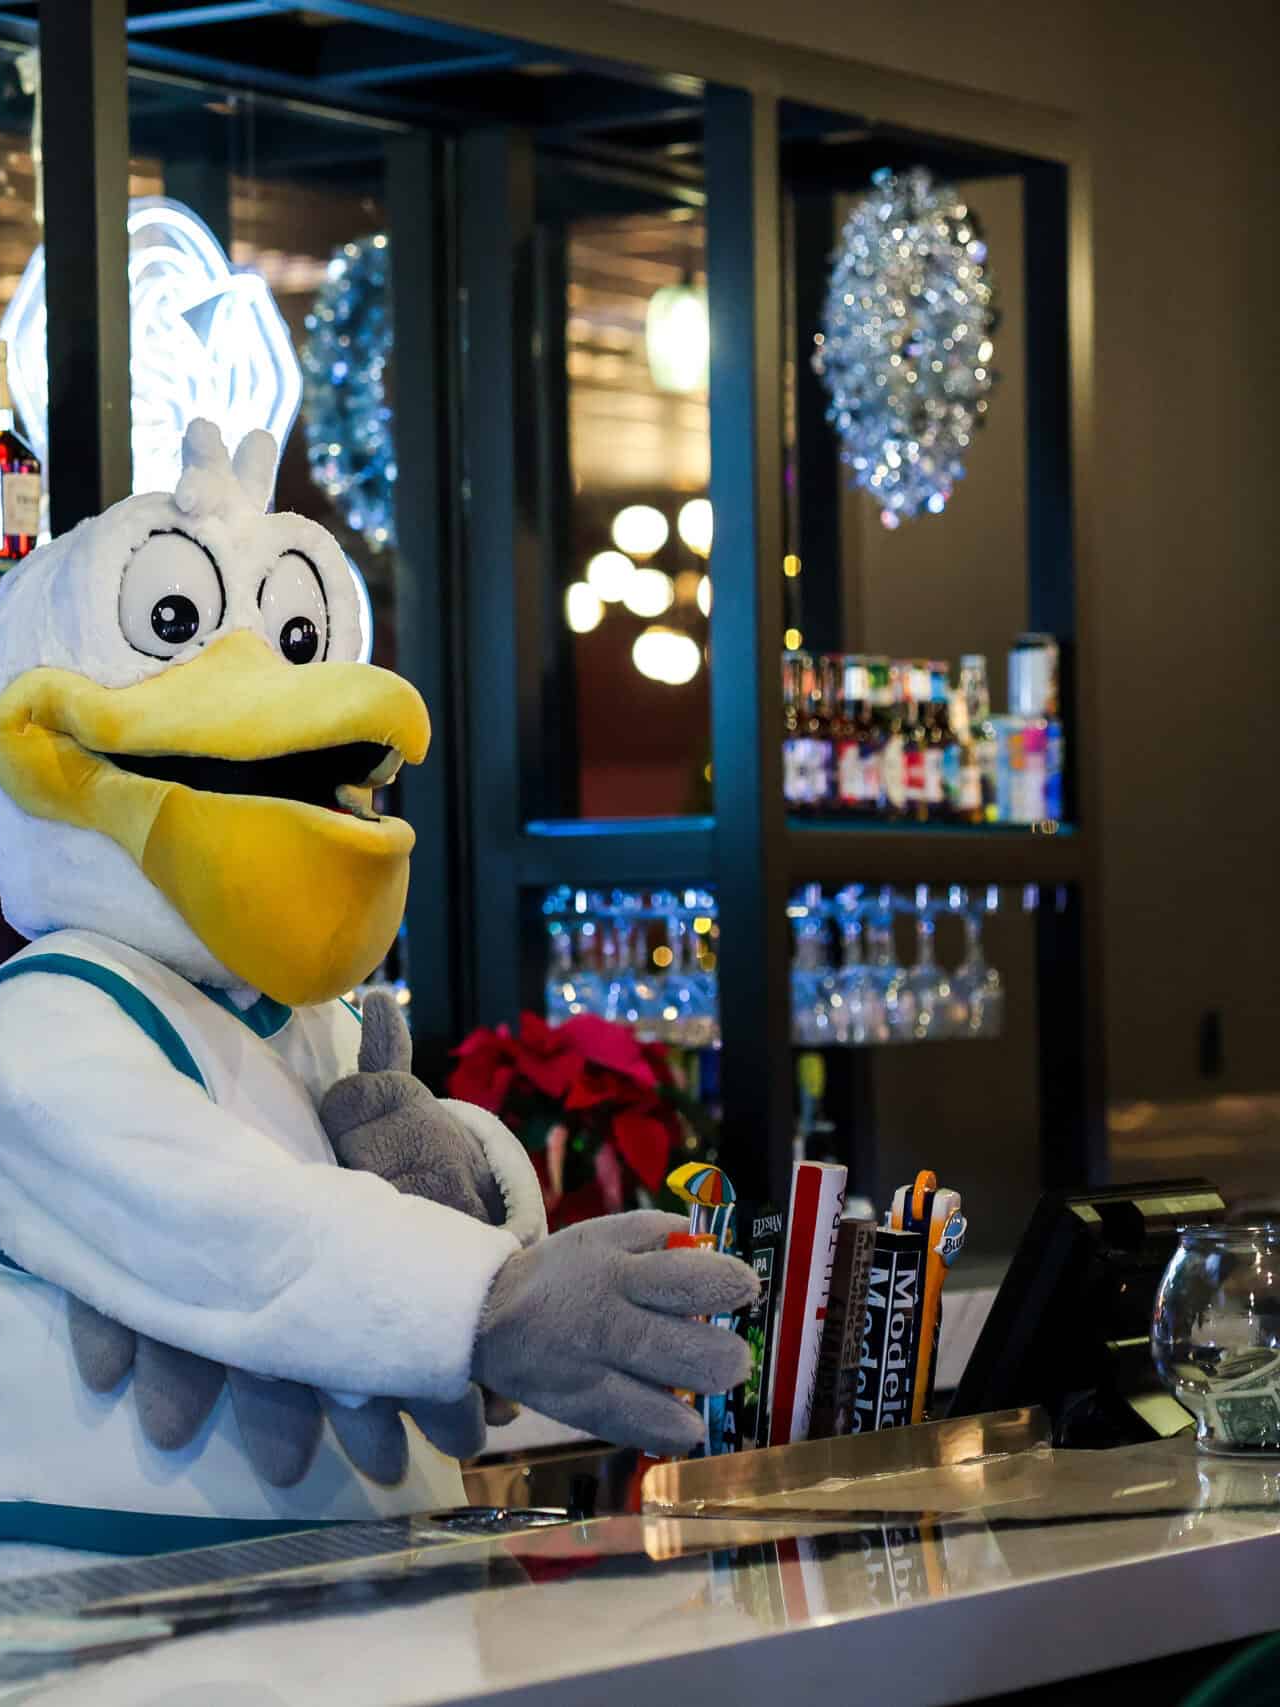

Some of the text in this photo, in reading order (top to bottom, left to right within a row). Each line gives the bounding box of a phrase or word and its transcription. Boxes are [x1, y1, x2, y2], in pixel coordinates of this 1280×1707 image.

[752, 1213, 782, 1238] ELYSIAN
[753, 1257, 768, 1273] IPA
[880, 1268, 918, 1430] Modelo
